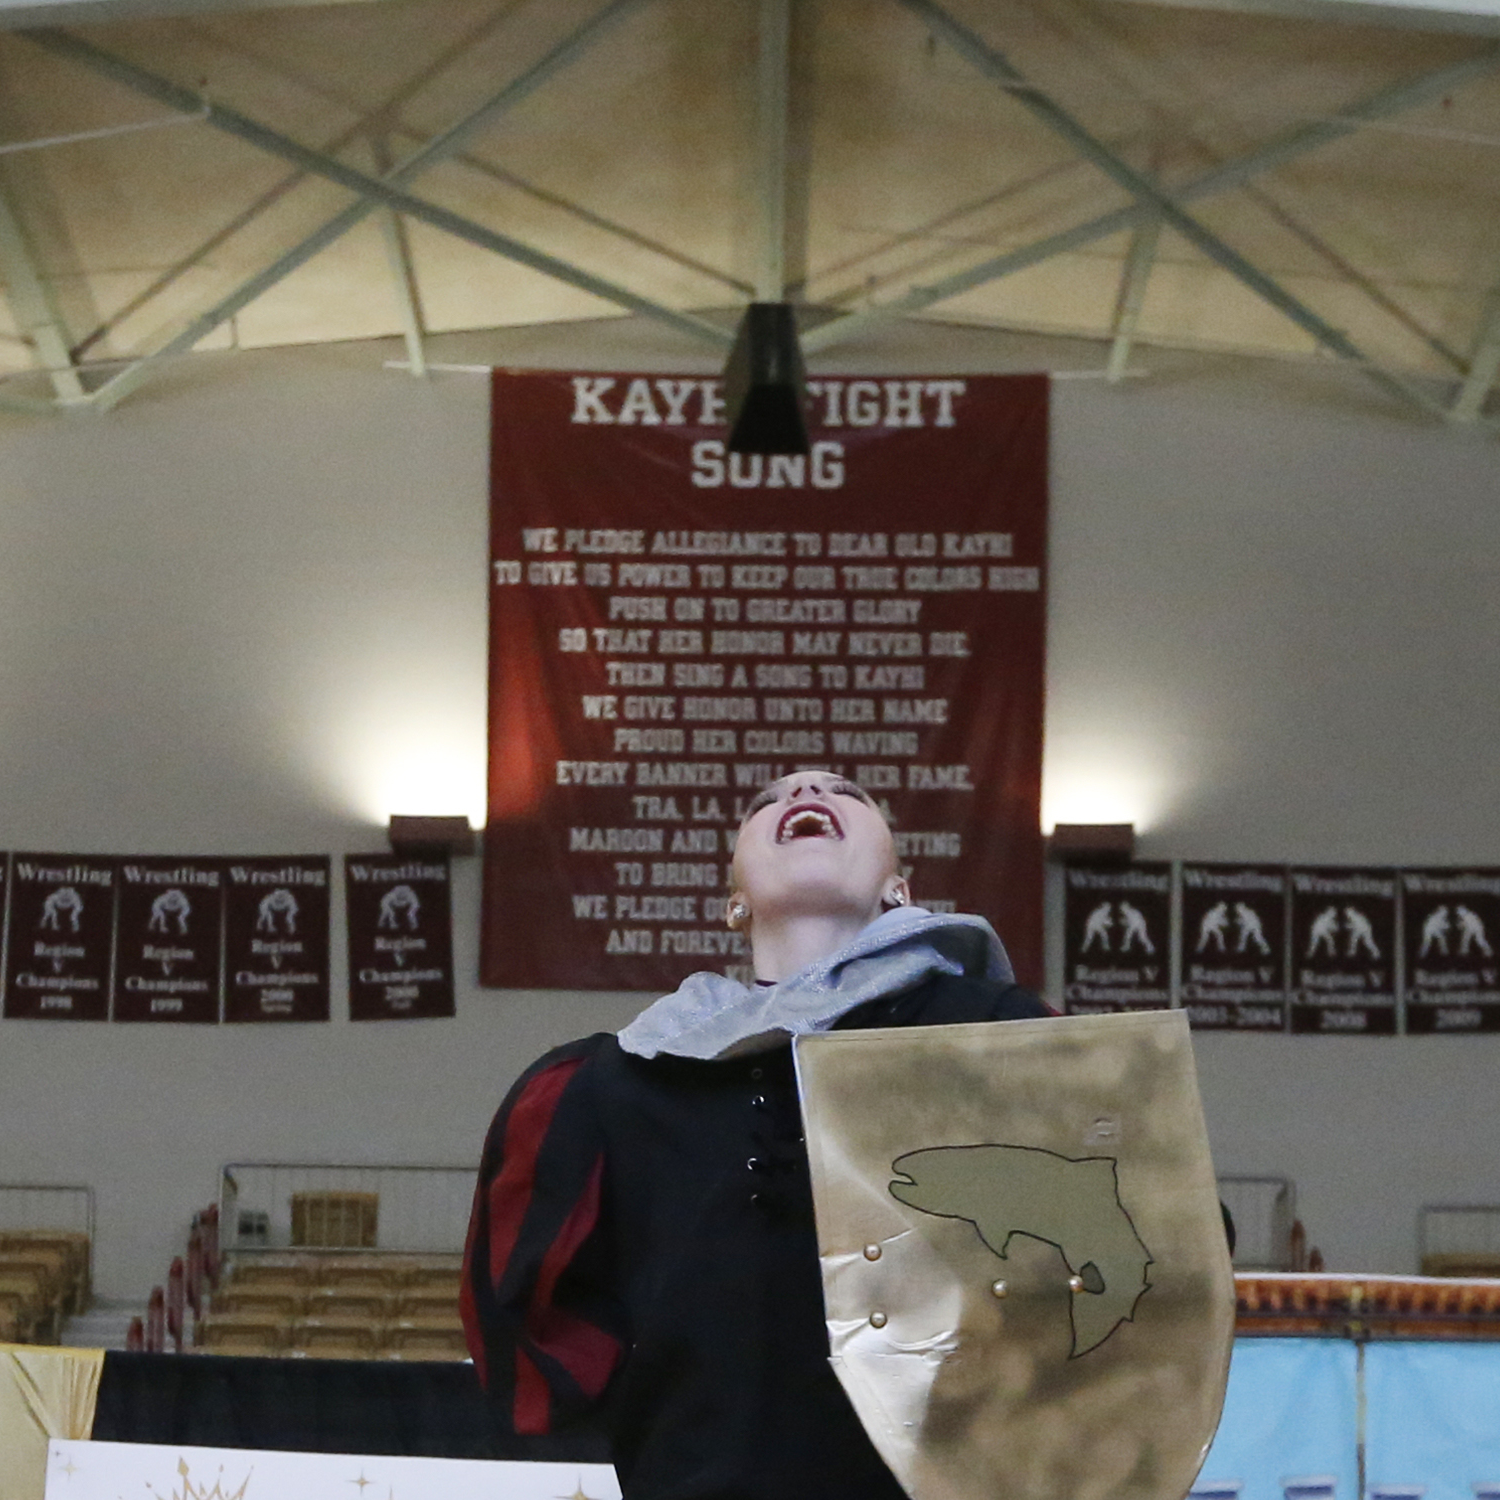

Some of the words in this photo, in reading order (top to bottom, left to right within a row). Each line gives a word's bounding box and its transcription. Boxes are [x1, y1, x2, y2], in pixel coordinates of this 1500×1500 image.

[570, 377, 728, 426] KAYH
[691, 440, 846, 490] SONG
[523, 528, 558, 552] WE
[564, 529, 645, 554] PLEDGE
[652, 531, 787, 556] ALLEGIANCE
[792, 532, 821, 557] TO
[827, 532, 888, 557] DEAR
[895, 532, 936, 557] OLD
[943, 532, 1012, 557] KAYHI
[494, 560, 522, 585] TO
[527, 561, 577, 586] GIVE
[583, 563, 611, 587] US
[618, 563, 691, 587] POWER
[696, 564, 725, 588] TO
[731, 564, 788, 590] KEEP
[904, 566, 982, 591] COLORS
[609, 596, 667, 620] PUSH
[673, 598, 705, 622] ON
[711, 598, 739, 621] TO
[746, 598, 846, 623] GREATER
[853, 599, 922, 624] GLORY
[559, 627, 587, 652] SO
[592, 628, 652, 653] THAT
[658, 629, 703, 654] HER
[711, 630, 784, 655] HONOR
[792, 631, 842, 656] MAY
[848, 632, 922, 656] NEVER
[606, 662, 665, 686] THEN
[673, 663, 724, 688] SING
[731, 664, 748, 688] A
[755, 664, 811, 689] SONG
[819, 665, 847, 690] TO
[854, 665, 924, 690] KAYHI
[582, 695, 618, 720] WE
[623, 696, 675, 720] GIVE
[682, 697, 757, 721] HONOR
[763, 697, 823, 723] UNTO
[830, 698, 875, 723] HER
[883, 698, 948, 724] NAME
[614, 728, 684, 753] PROUD
[693, 729, 736, 754] HER
[744, 730, 825, 755] COLORS
[831, 731, 919, 756] WAVING
[556, 761, 630, 785] EVERY
[635, 762, 728, 787] BANNER
[856, 765, 900, 789] HER
[570, 827, 663, 853] MAROON
[670, 829, 718, 853] AND
[17, 862, 112, 886] Wrestling
[123, 865, 219, 887] Wrestling
[230, 866, 325, 887] Wrestling
[352, 863, 446, 882] Wrestling
[615, 862, 643, 886] TO
[651, 863, 718, 887] BRING
[572, 895, 608, 919] WE
[615, 896, 697, 920] PLEDGE
[606, 929, 653, 954] AND
[660, 930, 747, 954] FOREVE
